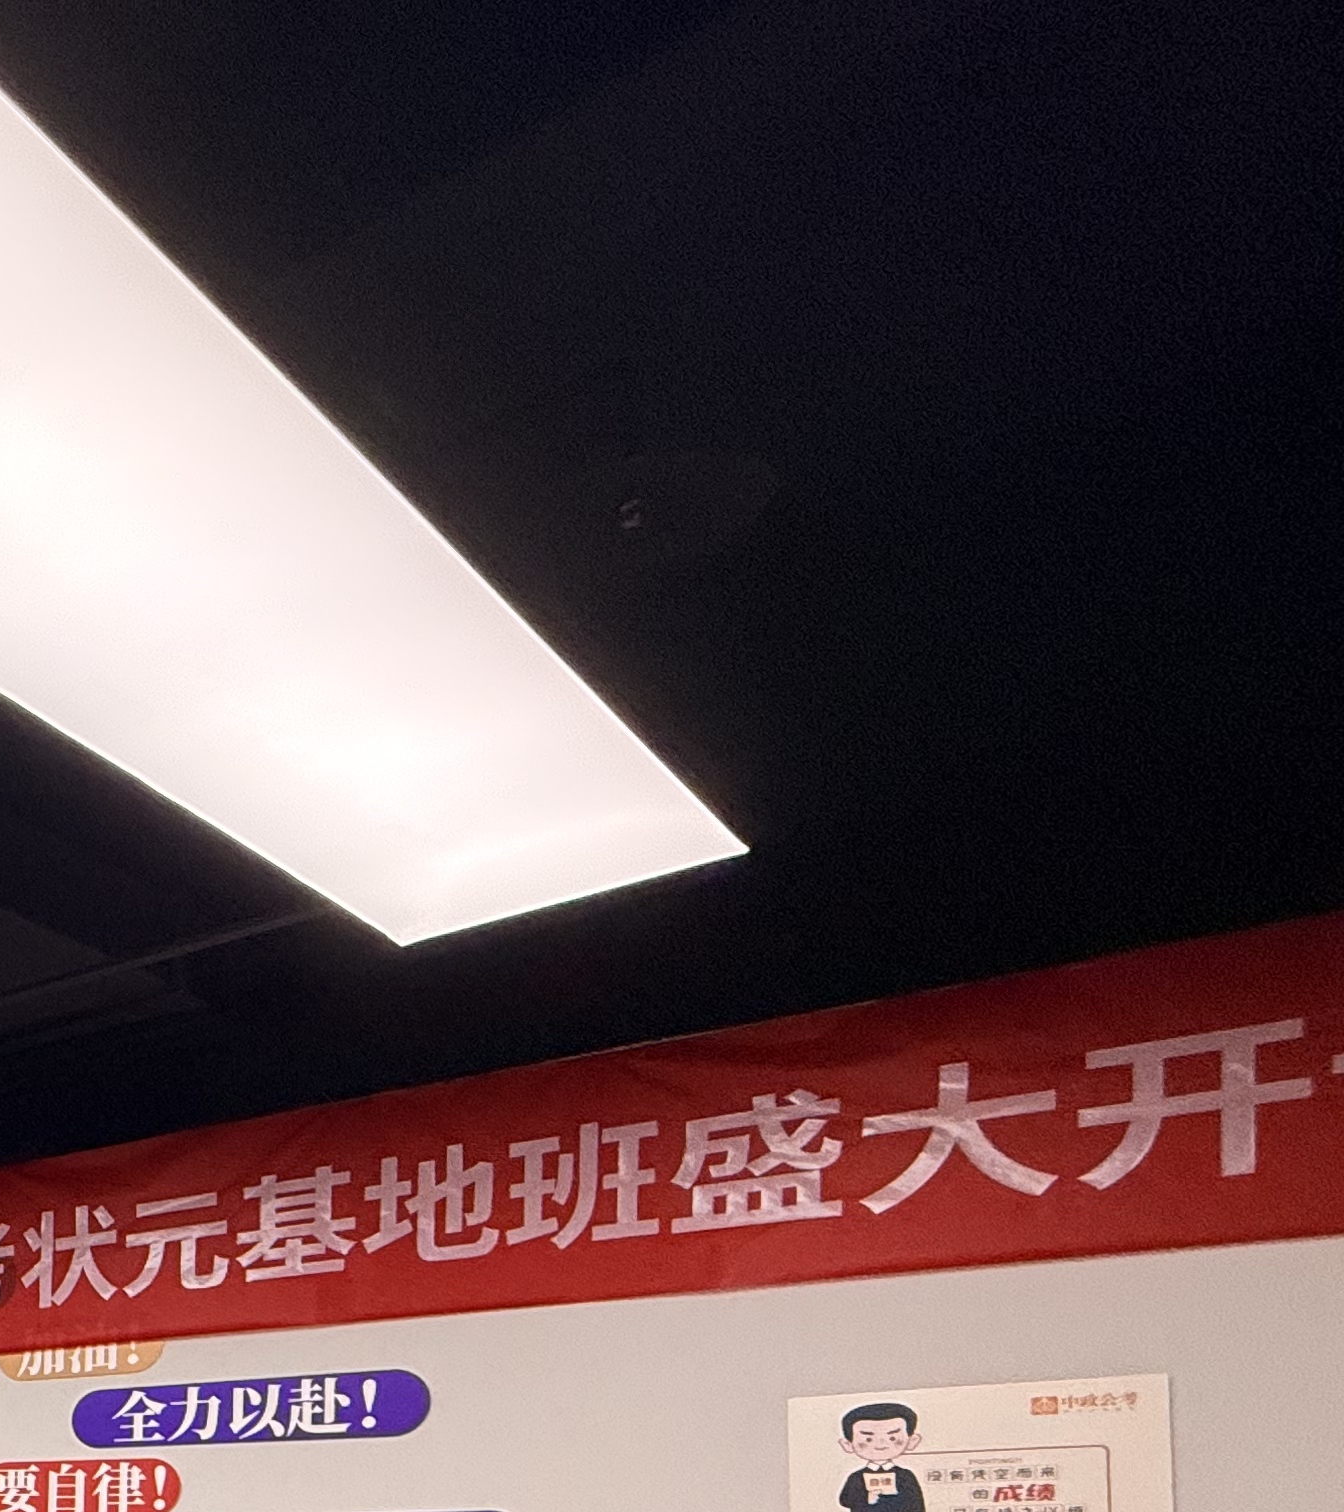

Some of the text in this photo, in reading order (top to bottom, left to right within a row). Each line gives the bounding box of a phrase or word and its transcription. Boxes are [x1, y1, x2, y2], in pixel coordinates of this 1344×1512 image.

[112, 1377, 380, 1443] 全力以赴！
[972, 1483, 1056, 1503] 的成绩
